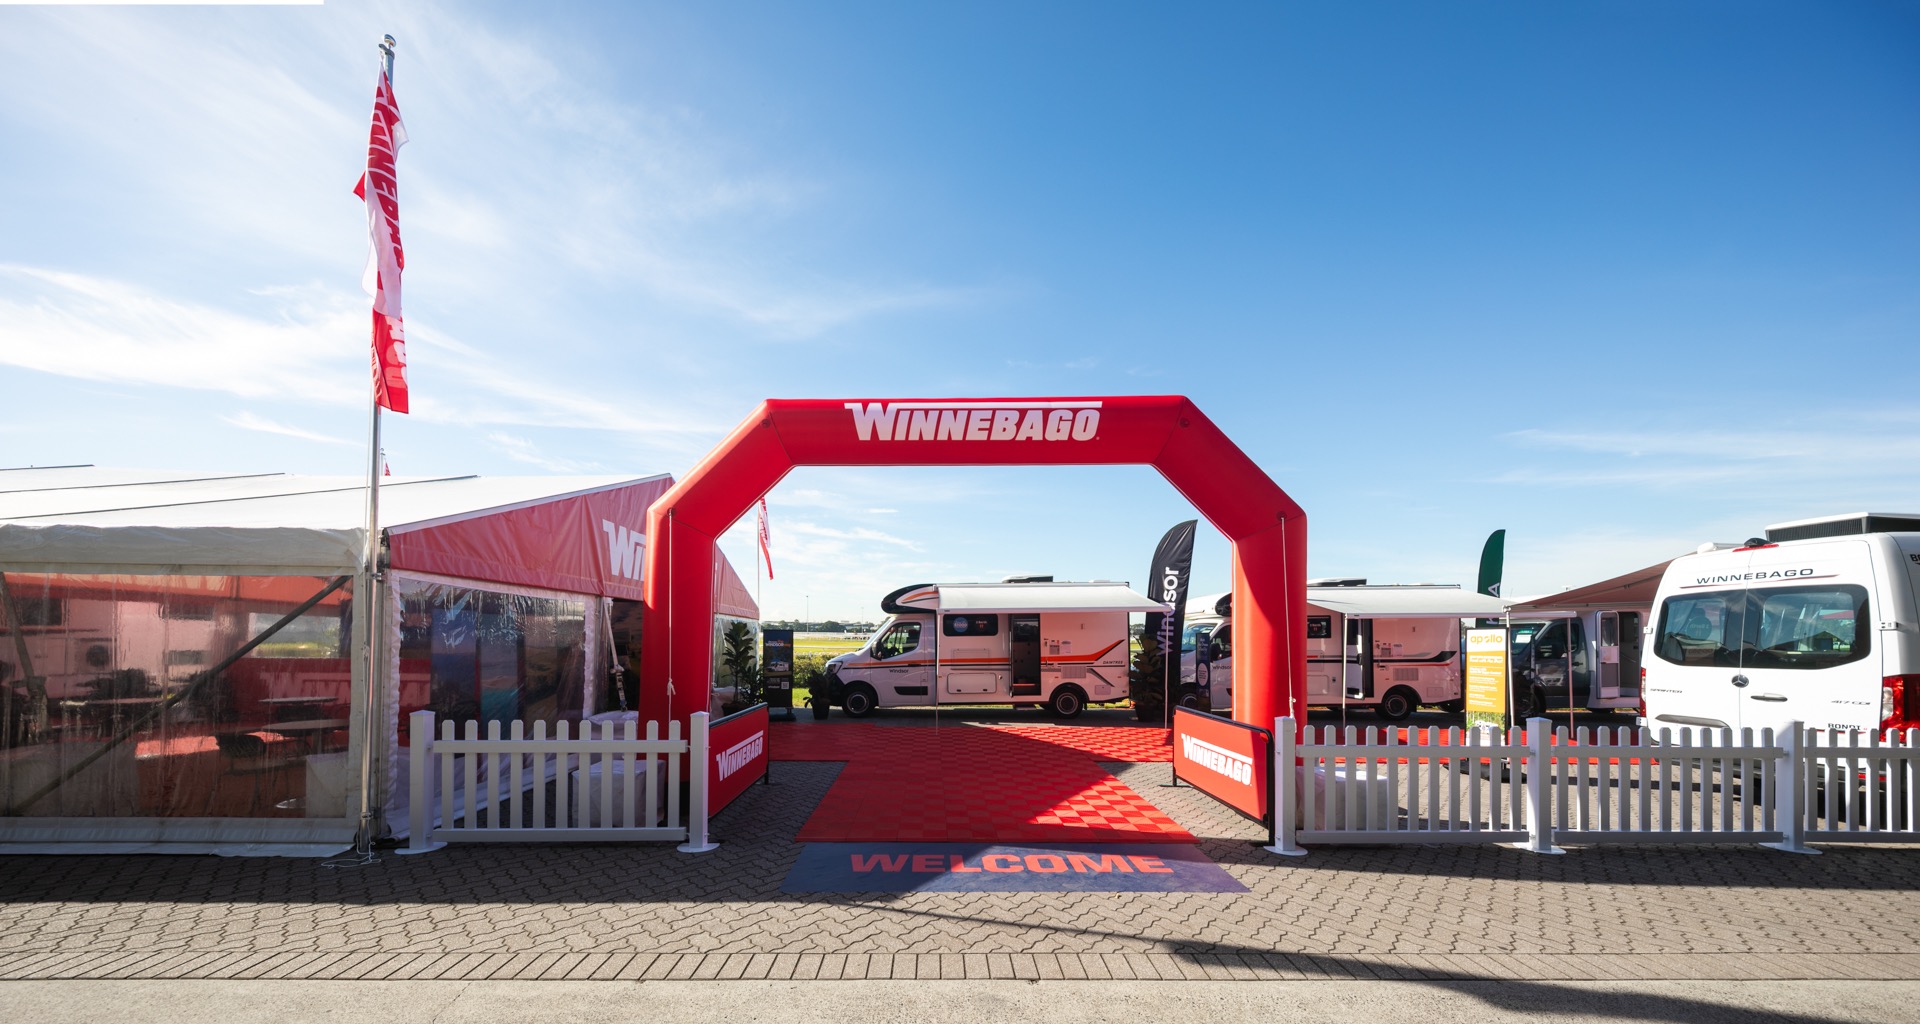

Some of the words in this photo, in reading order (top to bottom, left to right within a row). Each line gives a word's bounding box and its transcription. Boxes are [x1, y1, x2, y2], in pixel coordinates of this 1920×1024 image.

[844, 400, 1102, 441] WINNEBAGO
[1697, 568, 1814, 585] WINNEBAGO
[716, 730, 764, 781] WINNEBAGO
[1181, 733, 1253, 786] WINNEBAGO
[851, 854, 1174, 873] WELCOME
